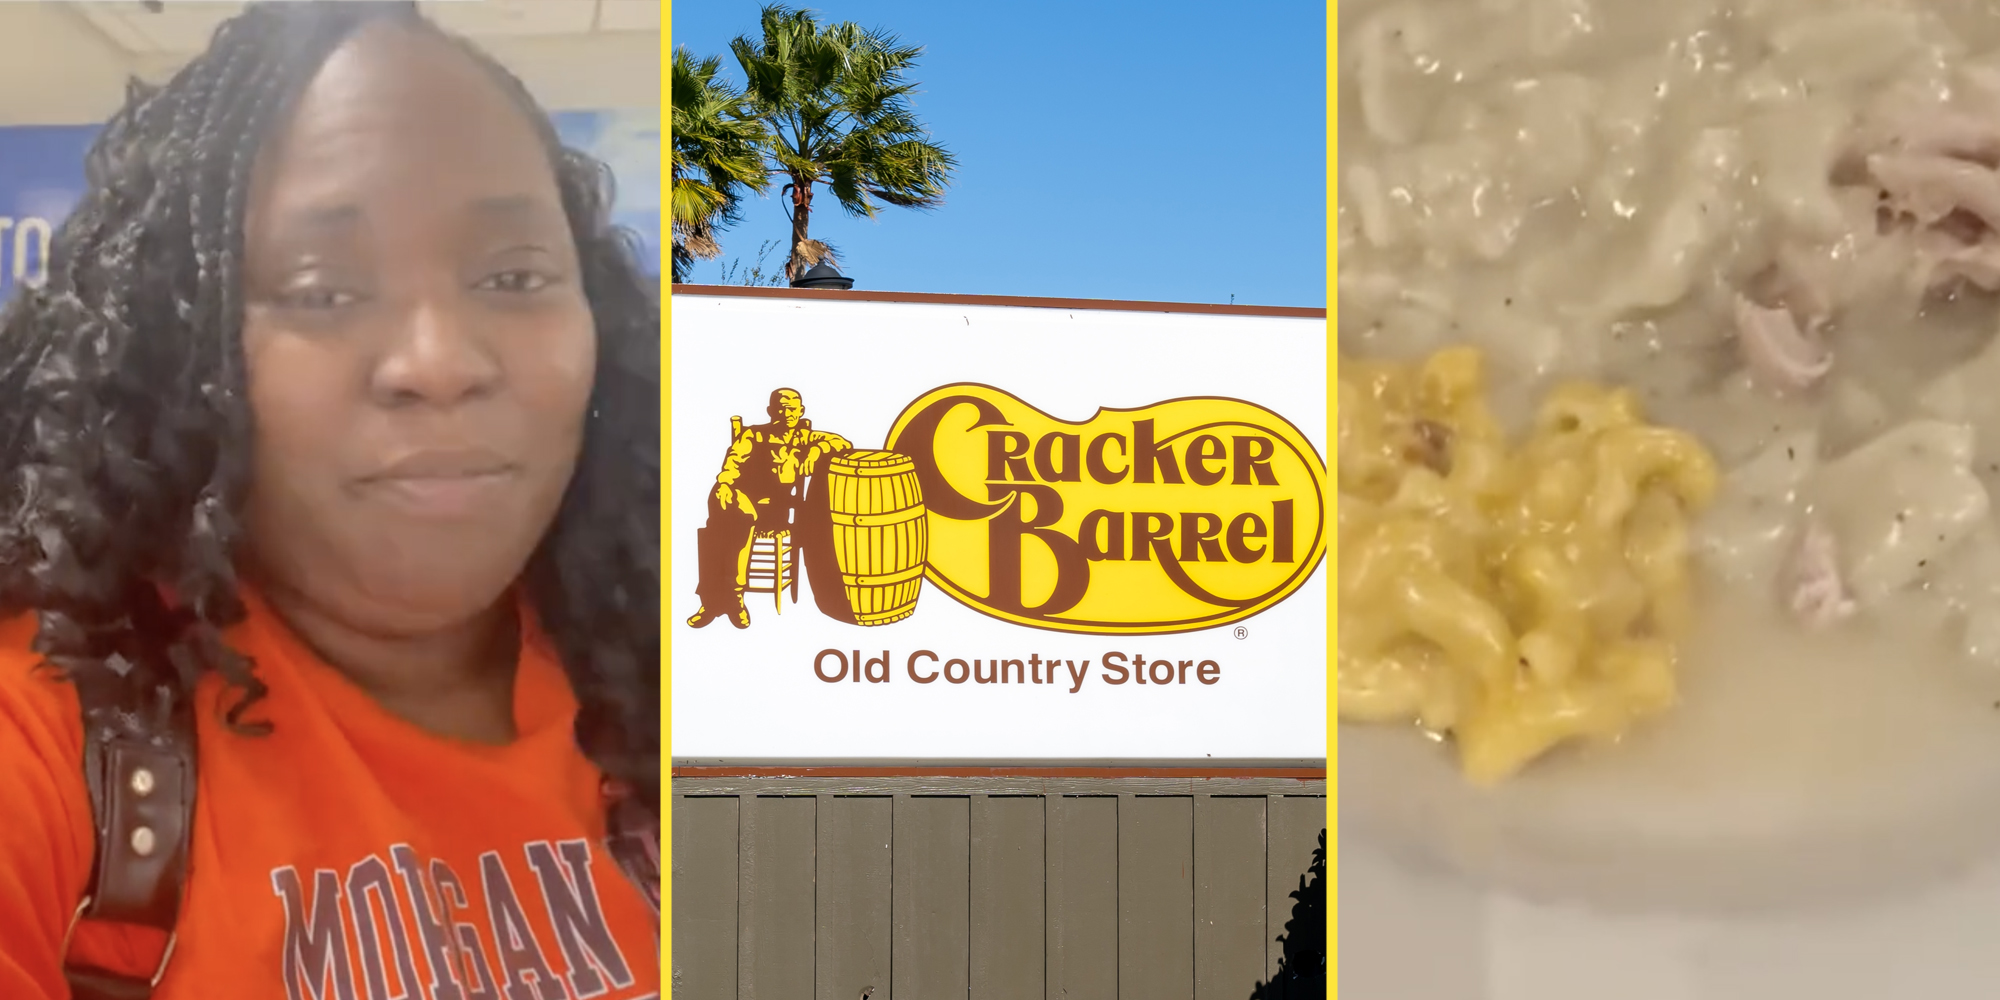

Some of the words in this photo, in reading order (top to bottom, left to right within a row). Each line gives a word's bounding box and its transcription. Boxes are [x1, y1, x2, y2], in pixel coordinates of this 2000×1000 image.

[814, 649, 890, 684] Old
[908, 649, 1090, 694] Country
[1102, 652, 1221, 686] Store
